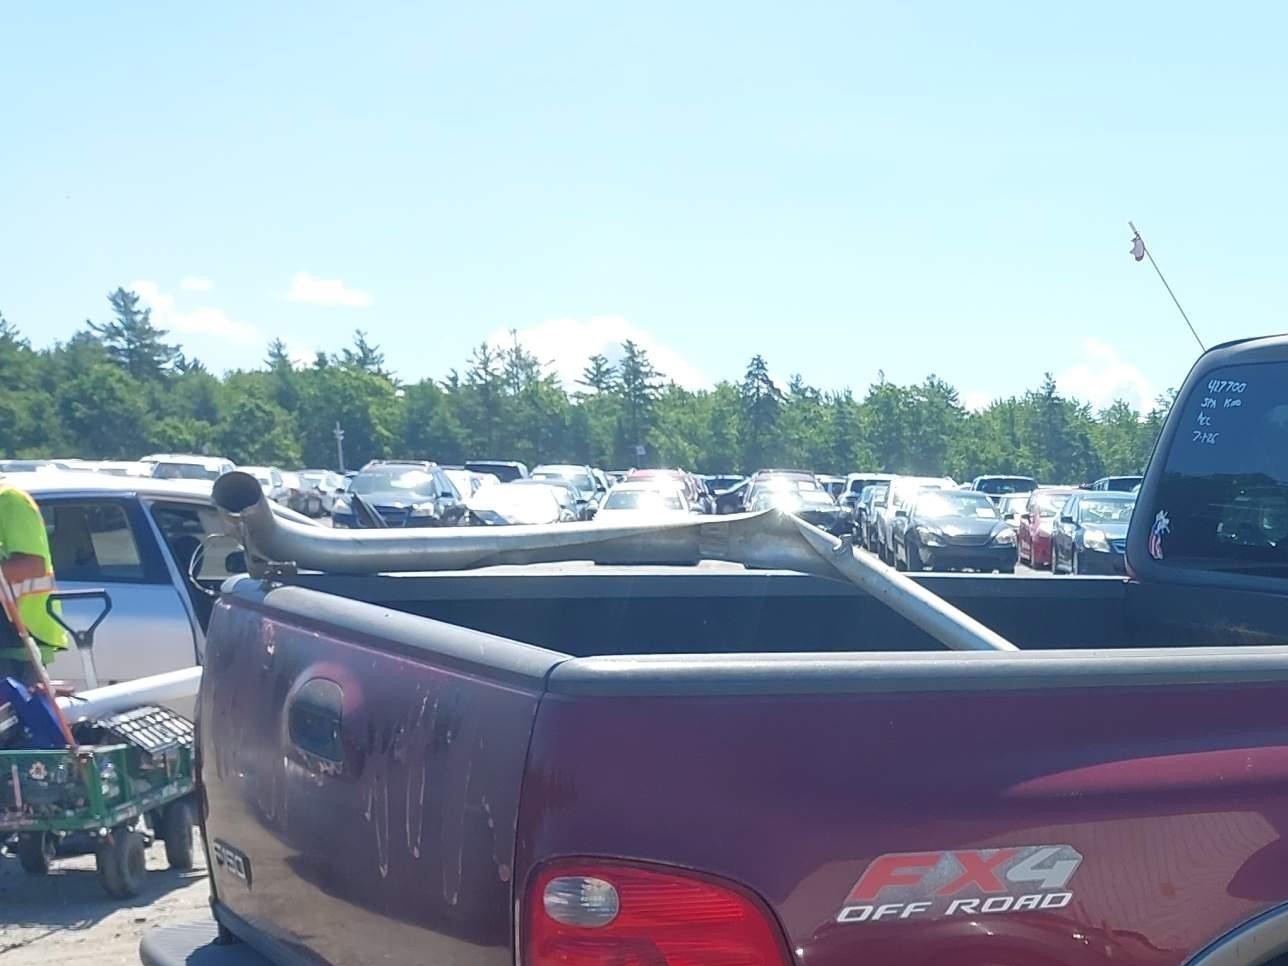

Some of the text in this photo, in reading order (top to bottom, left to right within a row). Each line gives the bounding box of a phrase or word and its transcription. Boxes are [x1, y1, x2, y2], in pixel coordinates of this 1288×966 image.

[849, 846, 1079, 902] FX4
[836, 892, 1073, 923] OFF ROAD
